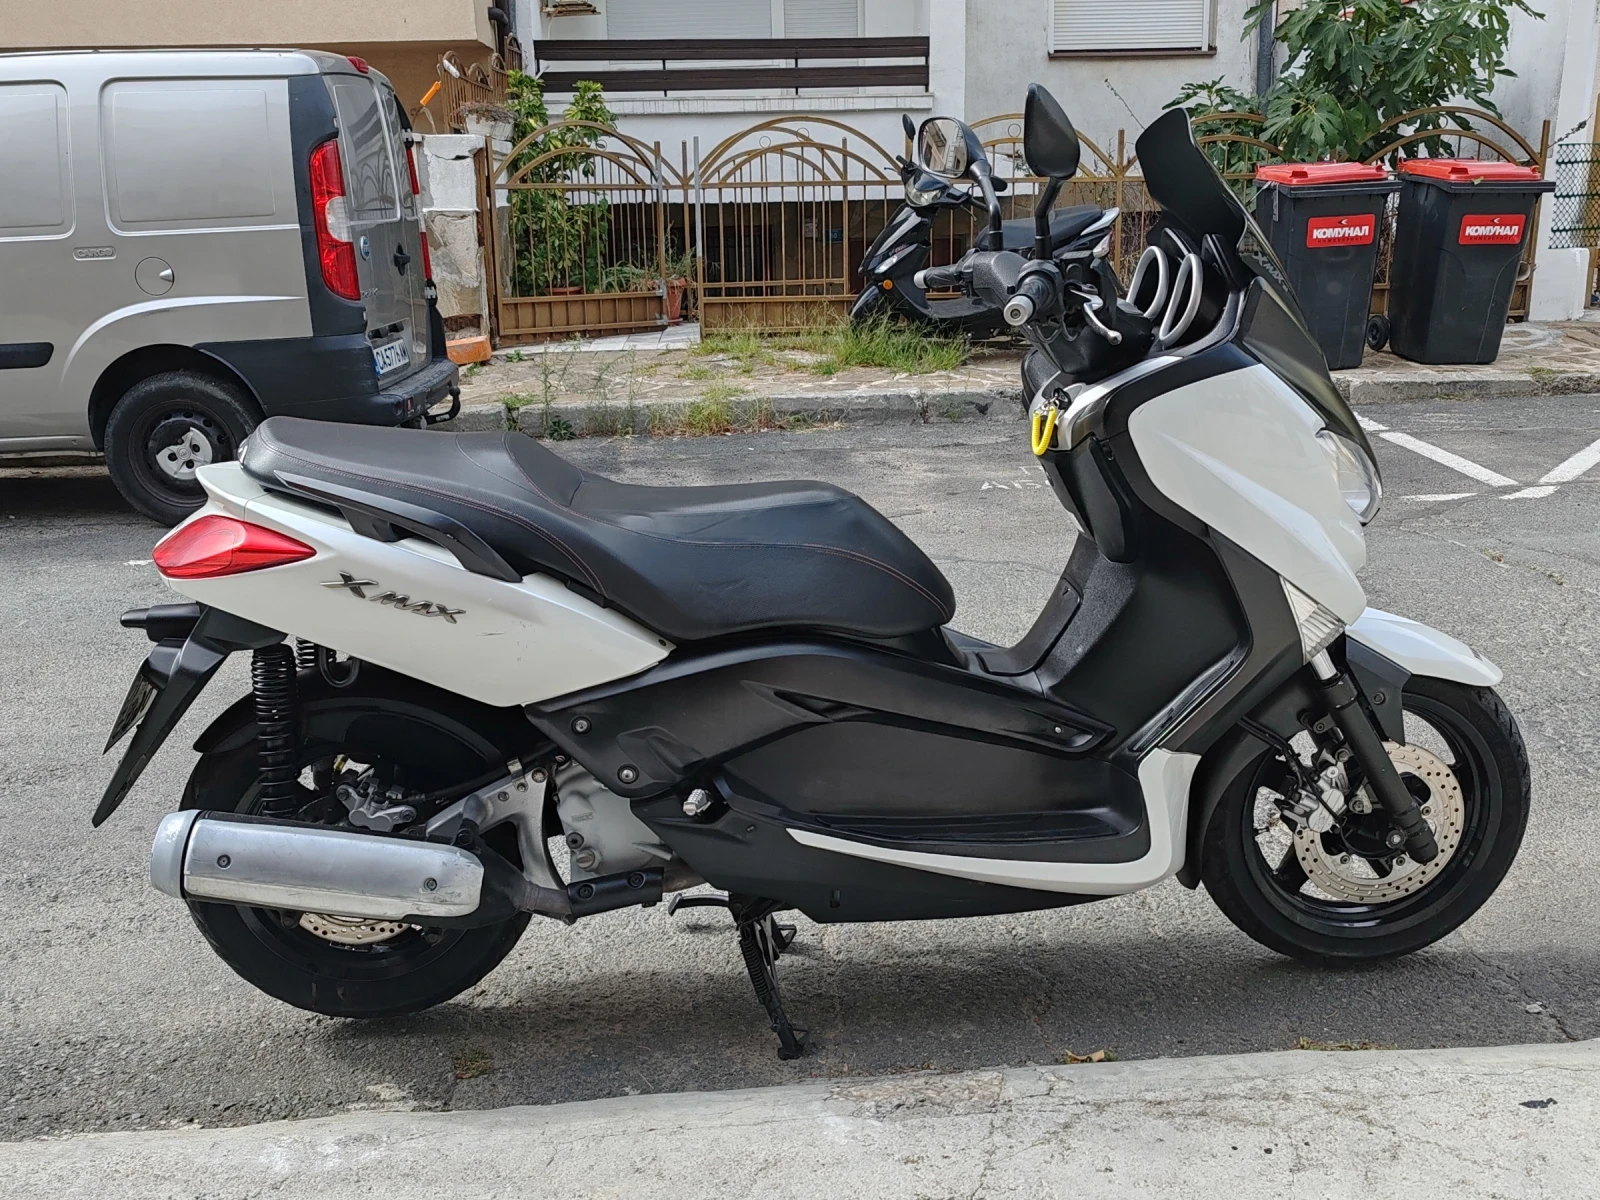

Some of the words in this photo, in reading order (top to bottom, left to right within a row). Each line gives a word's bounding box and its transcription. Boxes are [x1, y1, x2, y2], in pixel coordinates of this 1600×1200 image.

[1312, 225, 1370, 240] КОМУНАЛ
[1464, 225, 1520, 237] КОМУНАЛ
[75, 247, 115, 258] CARGO
